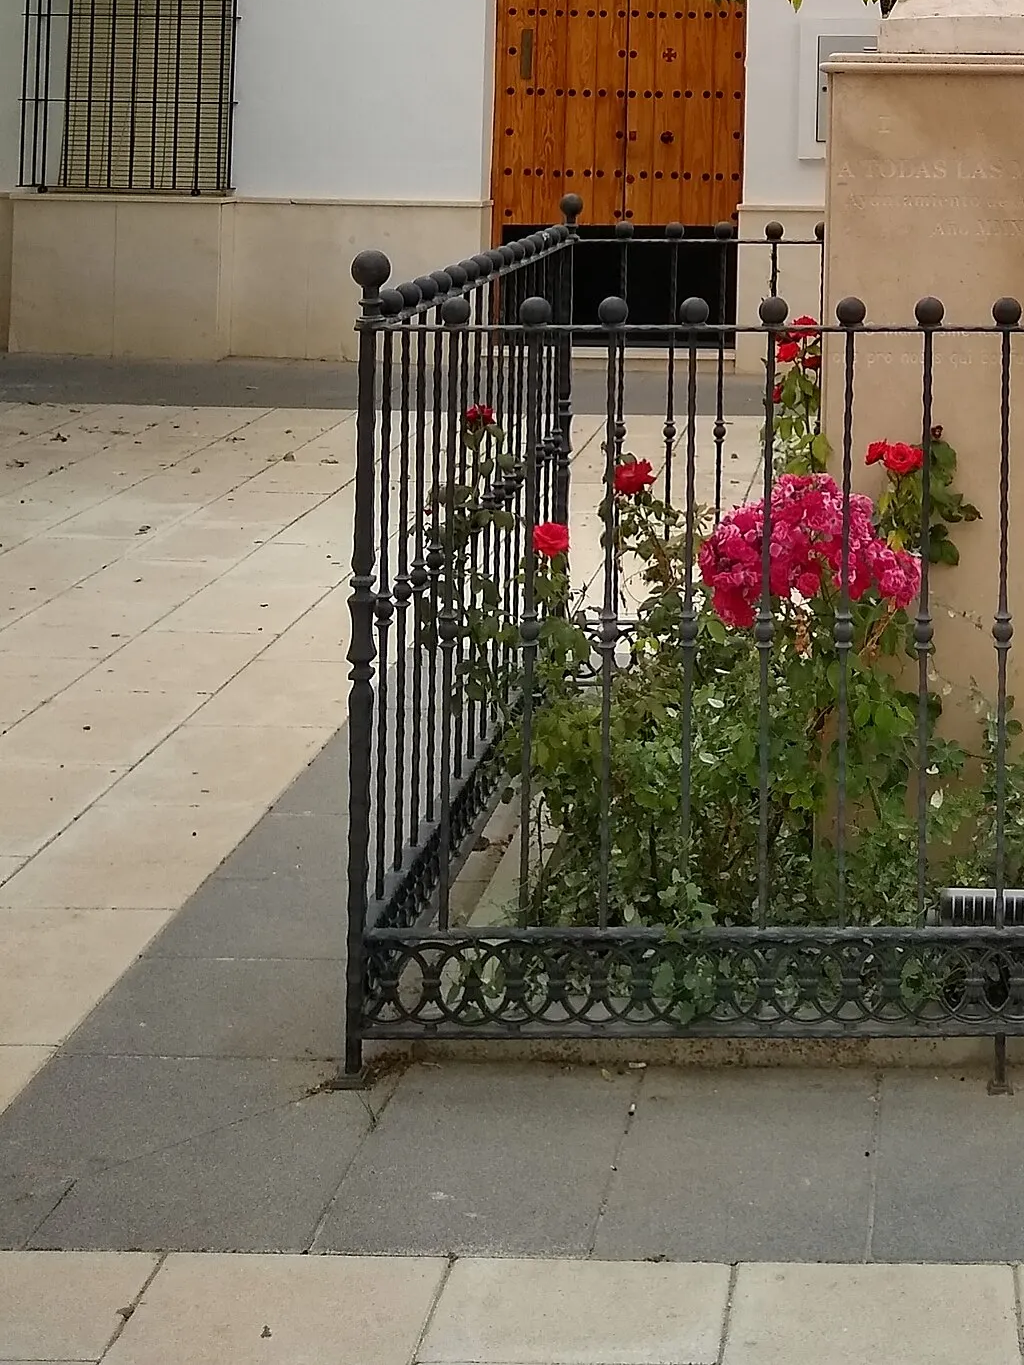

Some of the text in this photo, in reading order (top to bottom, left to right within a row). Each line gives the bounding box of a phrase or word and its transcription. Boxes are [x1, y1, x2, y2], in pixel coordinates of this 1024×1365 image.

[836, 160, 856, 178] A
[858, 158, 948, 178] TODAS
[955, 158, 1004, 179] LAS
